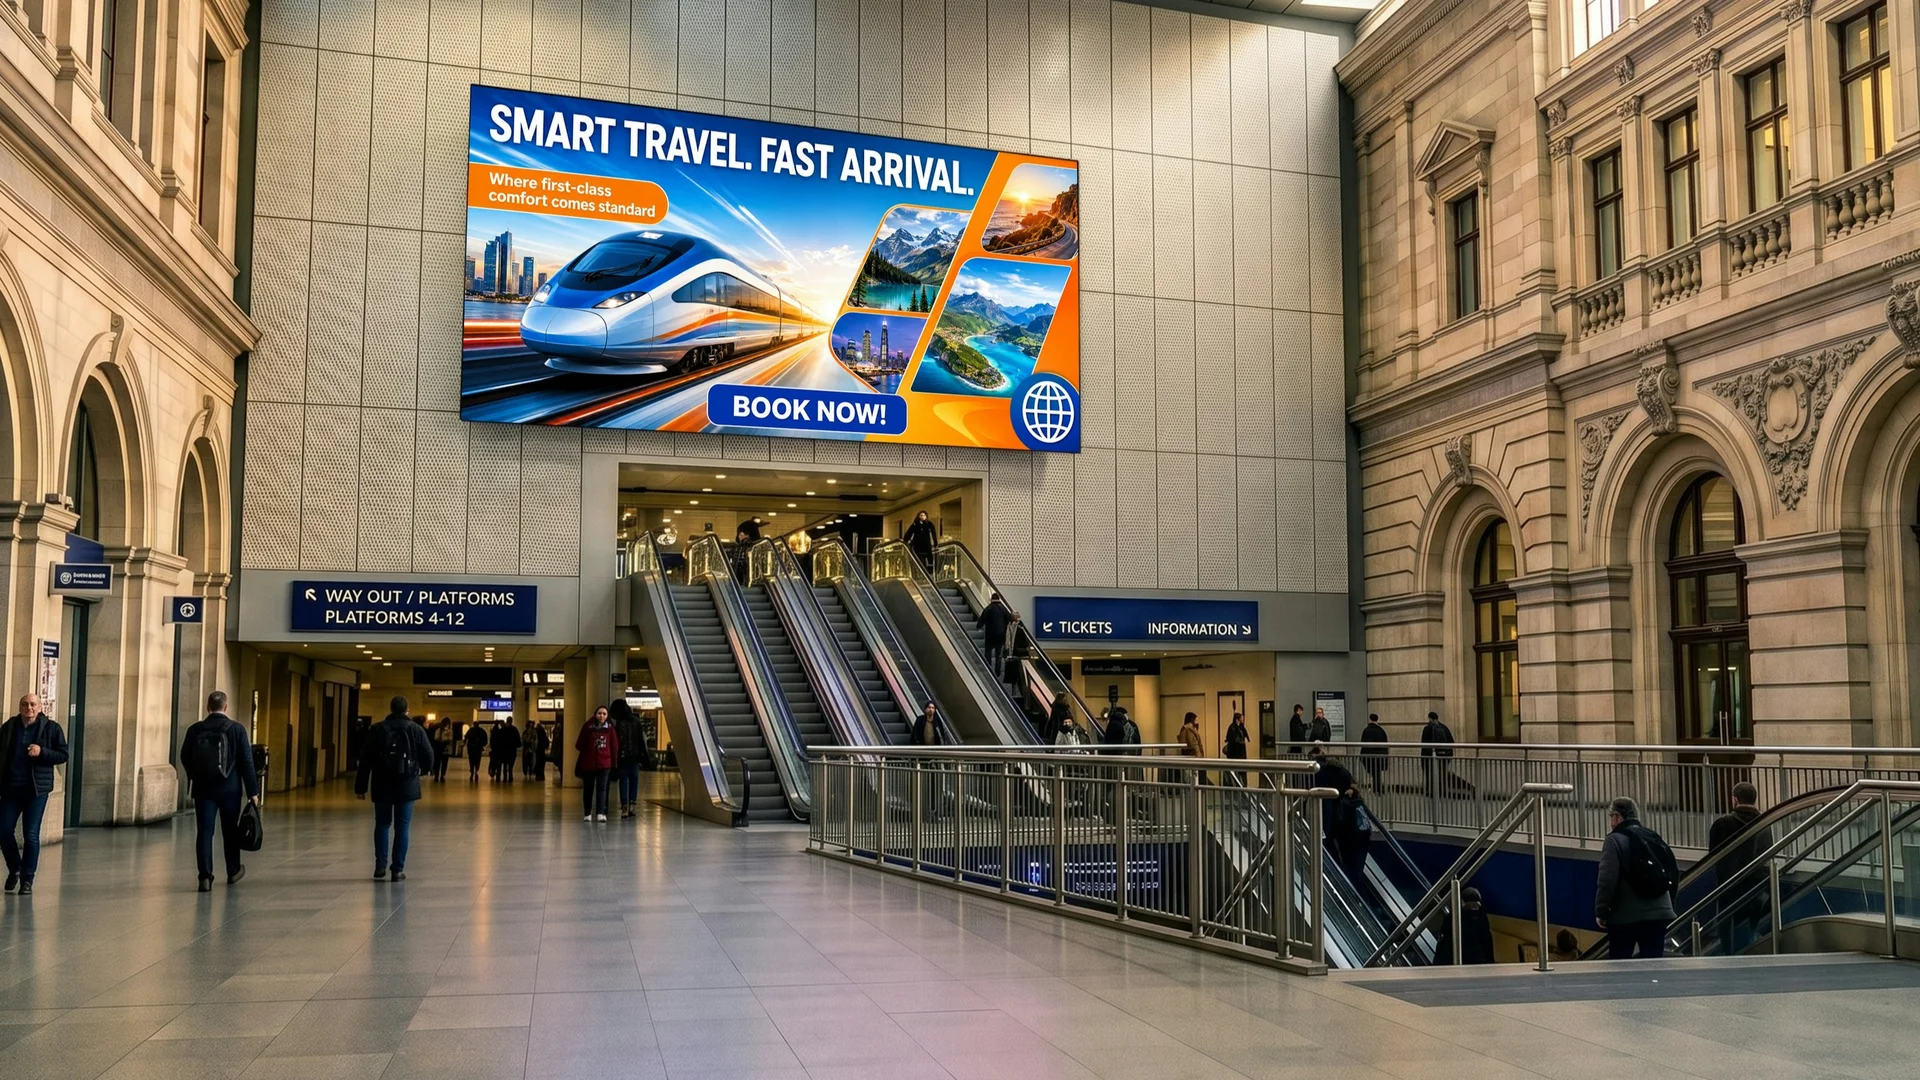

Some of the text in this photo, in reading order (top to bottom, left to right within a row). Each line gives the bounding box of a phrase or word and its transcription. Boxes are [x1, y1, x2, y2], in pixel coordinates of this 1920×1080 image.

[489, 104, 974, 196] SMART TRAVEL. FAST ARRIVAL.
[488, 172, 612, 197] Where first-class
[488, 190, 656, 218] comfort comes standard
[733, 395, 887, 426] BOOK NOW!
[325, 589, 515, 606] WAY OUT / PLATFORMS
[325, 610, 465, 626] PLATFORMS 4-12
[1058, 621, 1113, 635] TICKETS
[1148, 622, 1238, 636] INFORMATION
